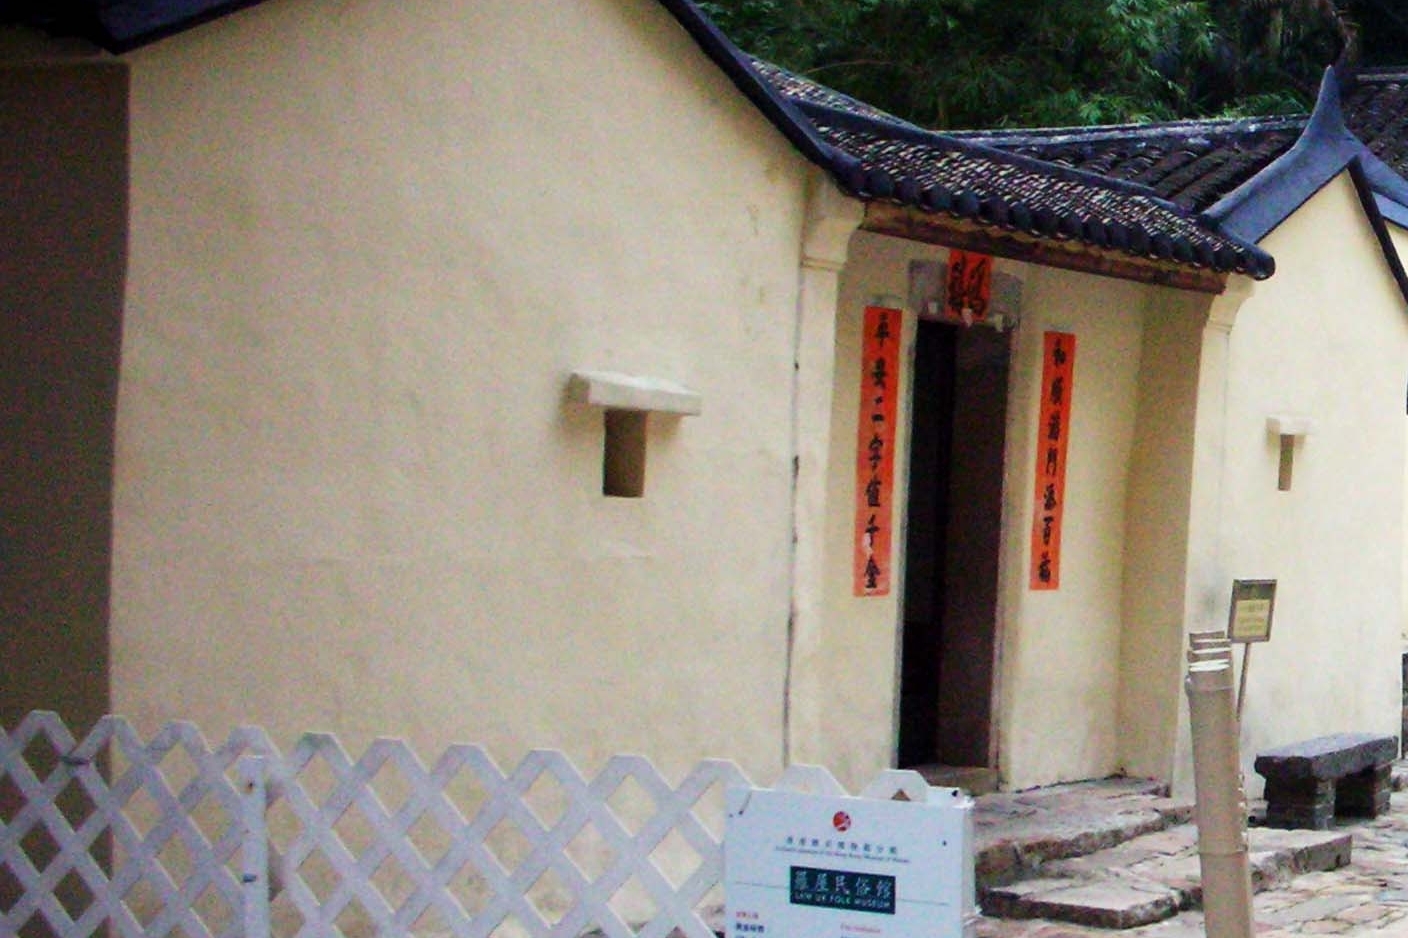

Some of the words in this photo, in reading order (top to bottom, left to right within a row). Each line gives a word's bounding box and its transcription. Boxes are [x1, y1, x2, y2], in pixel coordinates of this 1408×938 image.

[863, 311, 891, 589] 平安二字值千金
